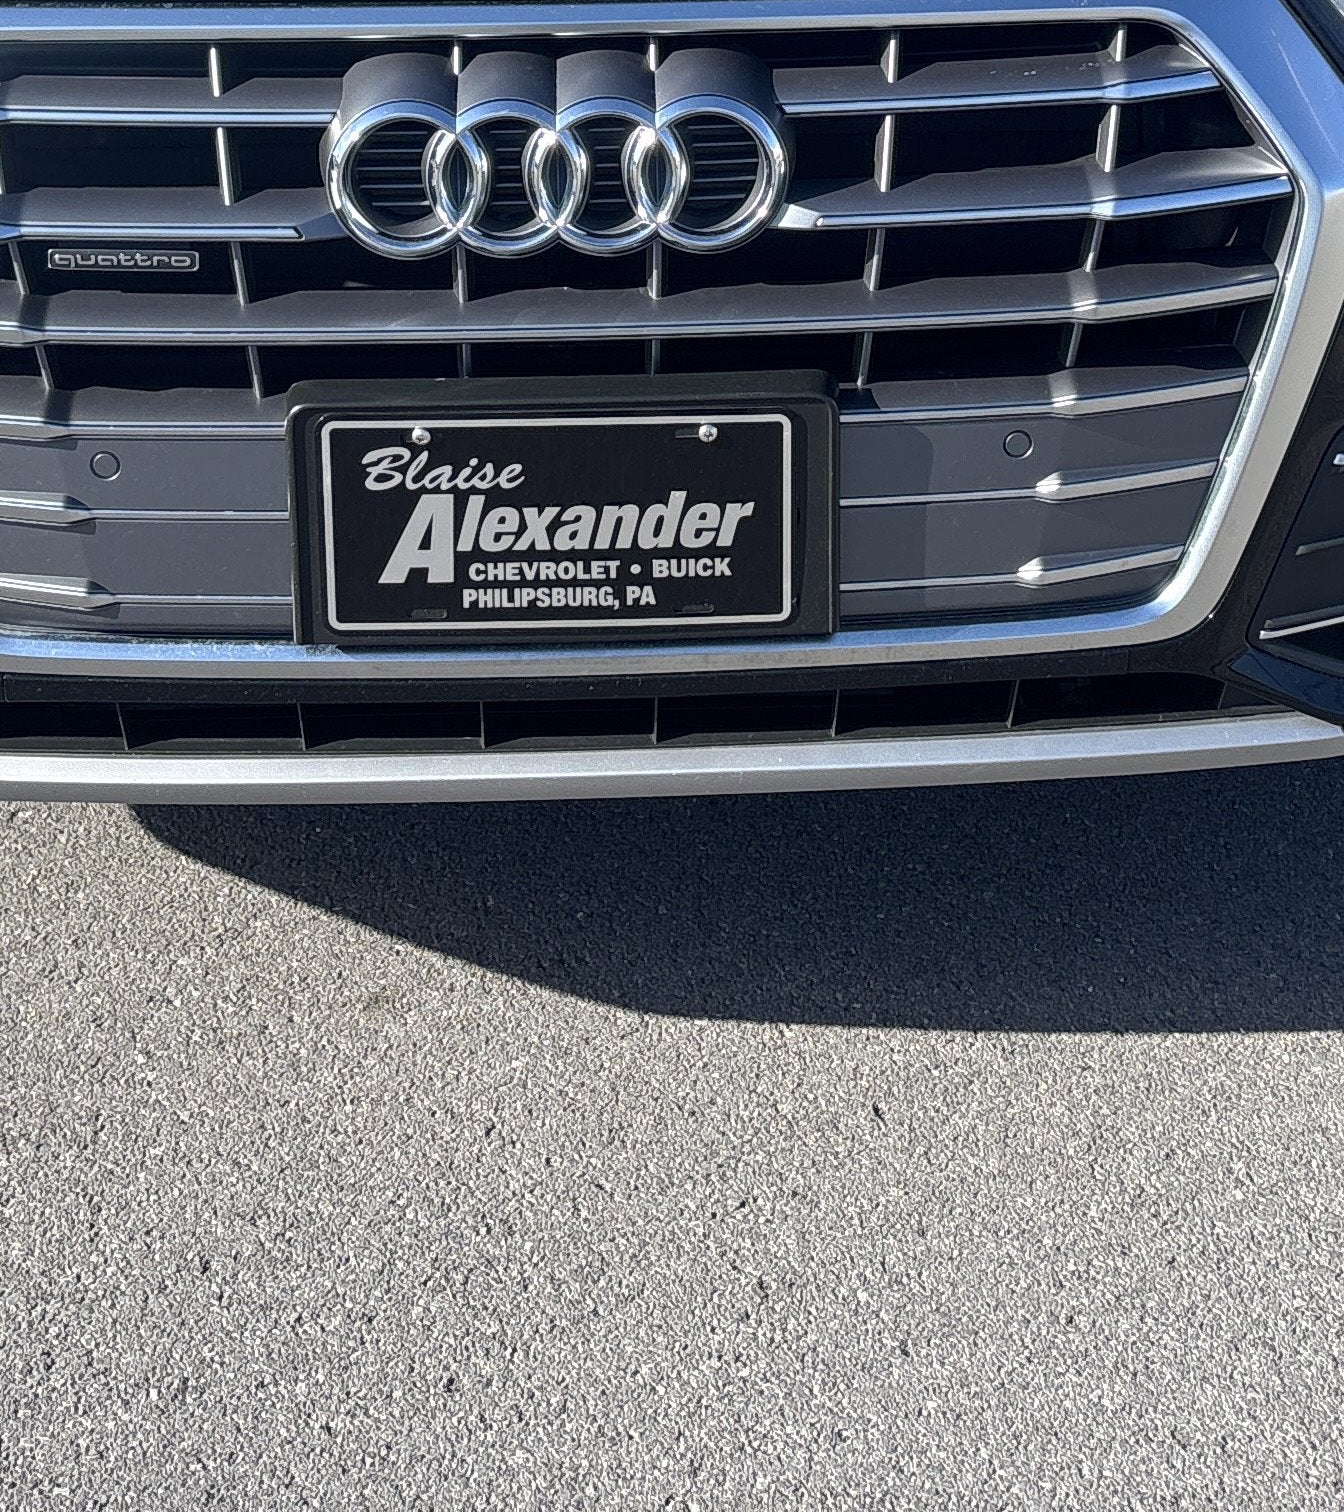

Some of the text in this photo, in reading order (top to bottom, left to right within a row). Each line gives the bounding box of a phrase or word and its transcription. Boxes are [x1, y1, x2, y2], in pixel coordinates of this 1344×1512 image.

[53, 252, 192, 268] quattro
[361, 446, 526, 491] Blaise
[377, 489, 755, 585] Alexander
[468, 556, 733, 582] CHEVROLET BUICK
[461, 584, 657, 611] PHILIPSBURG, PA
